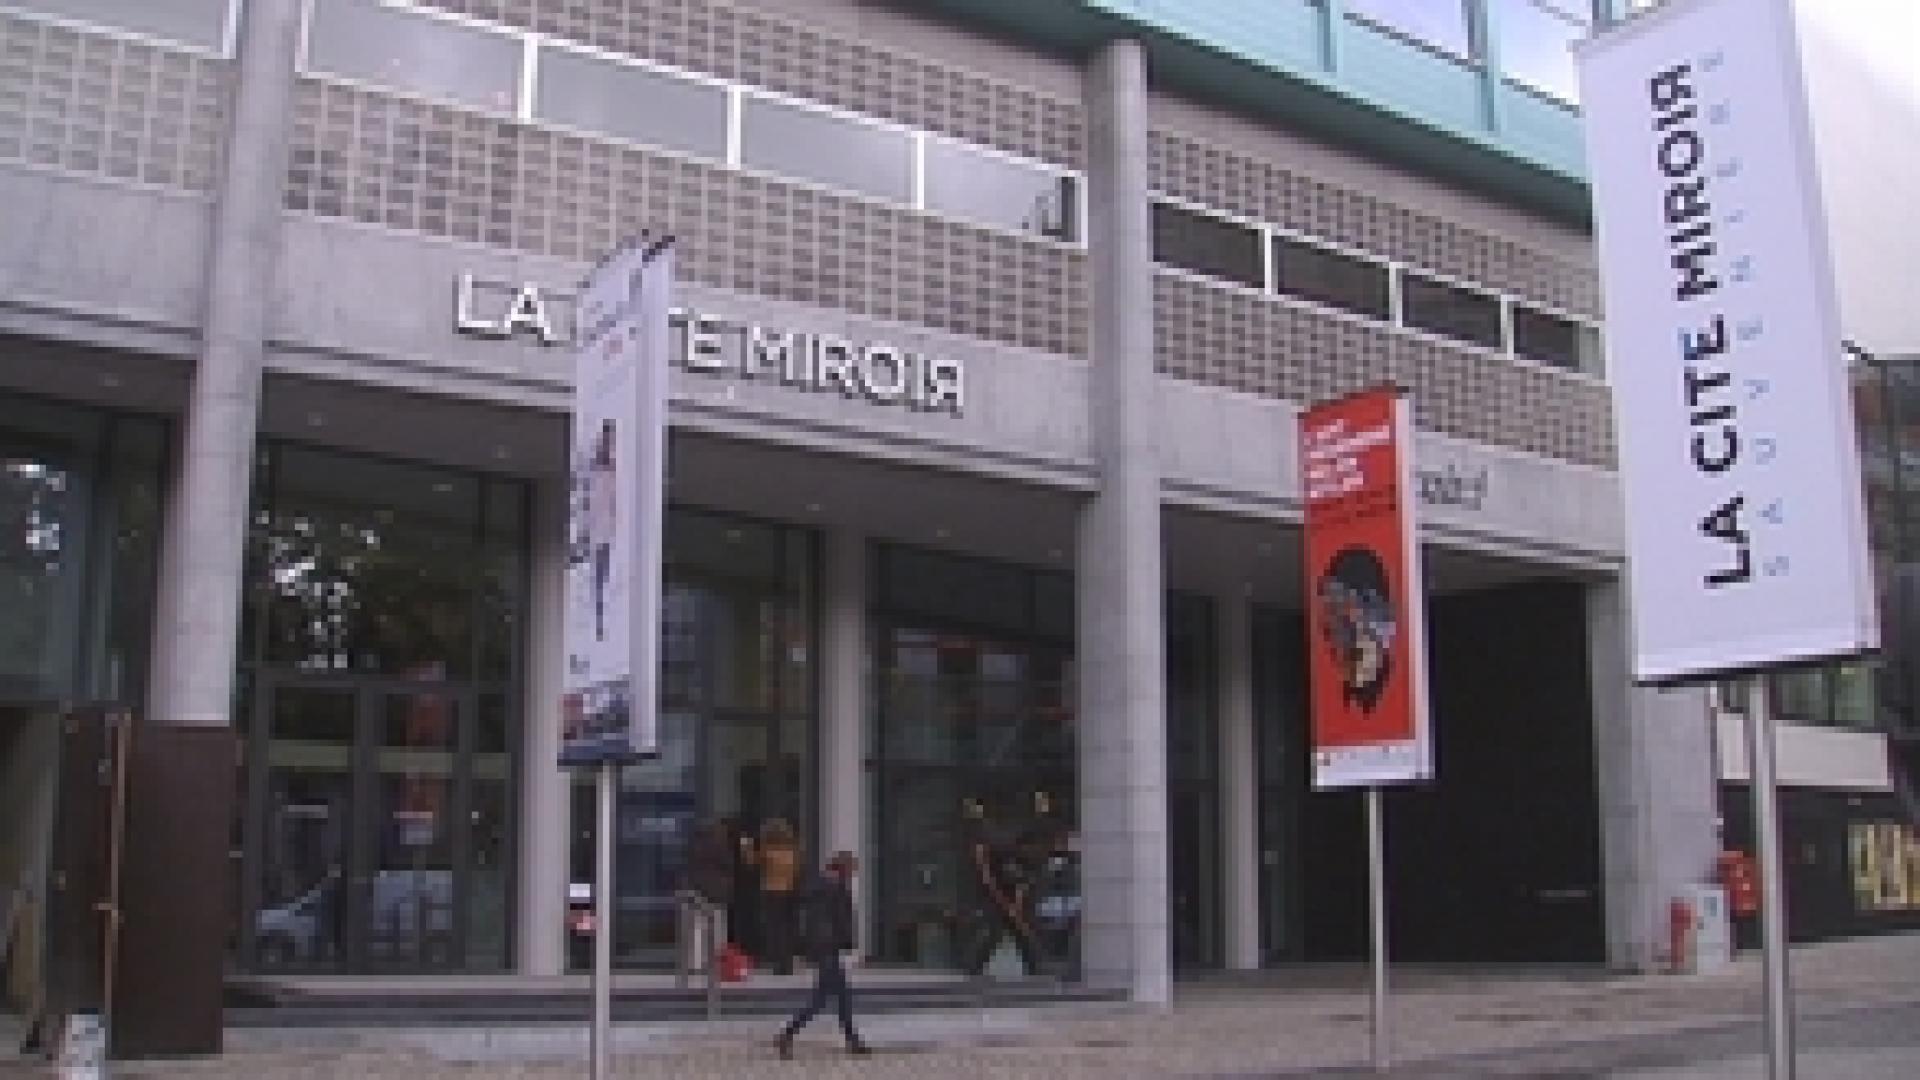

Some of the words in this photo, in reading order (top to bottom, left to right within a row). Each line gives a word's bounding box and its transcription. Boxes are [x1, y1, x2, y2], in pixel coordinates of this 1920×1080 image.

[456, 272, 553, 346] LA
[1680, 314, 1741, 475] CITE
[1700, 494, 1752, 590] LA
